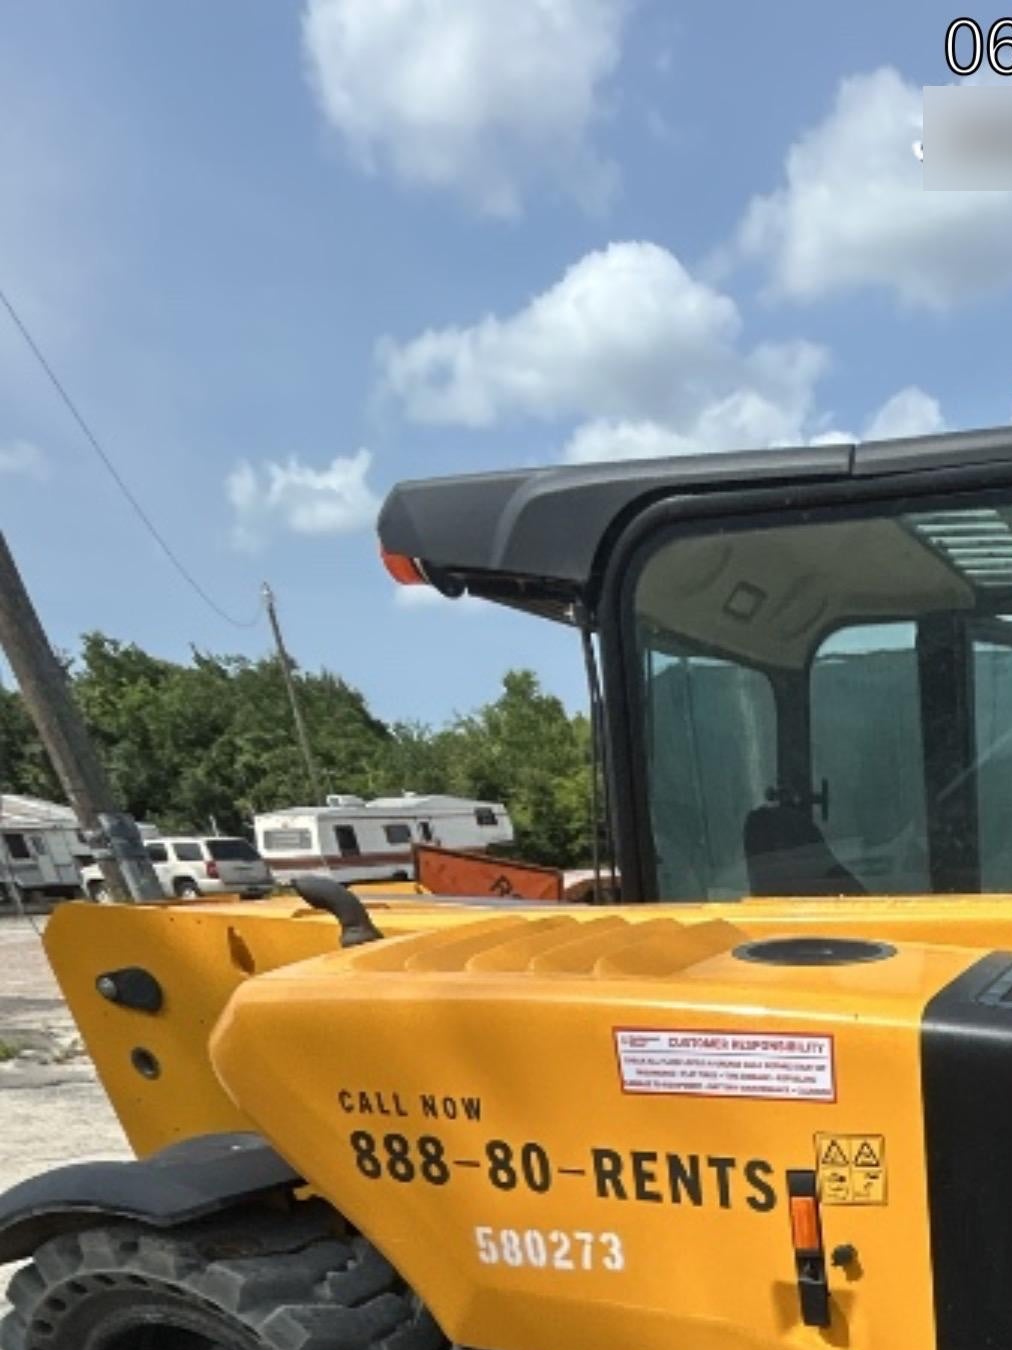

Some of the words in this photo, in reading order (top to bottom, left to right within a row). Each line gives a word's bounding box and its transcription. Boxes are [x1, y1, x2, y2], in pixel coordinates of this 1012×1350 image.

[338, 1089, 408, 1118] CALL
[421, 1094, 481, 1121] NOW
[349, 1130, 777, 1212] 888-80-RENTS
[474, 1225, 625, 1271] 580273
